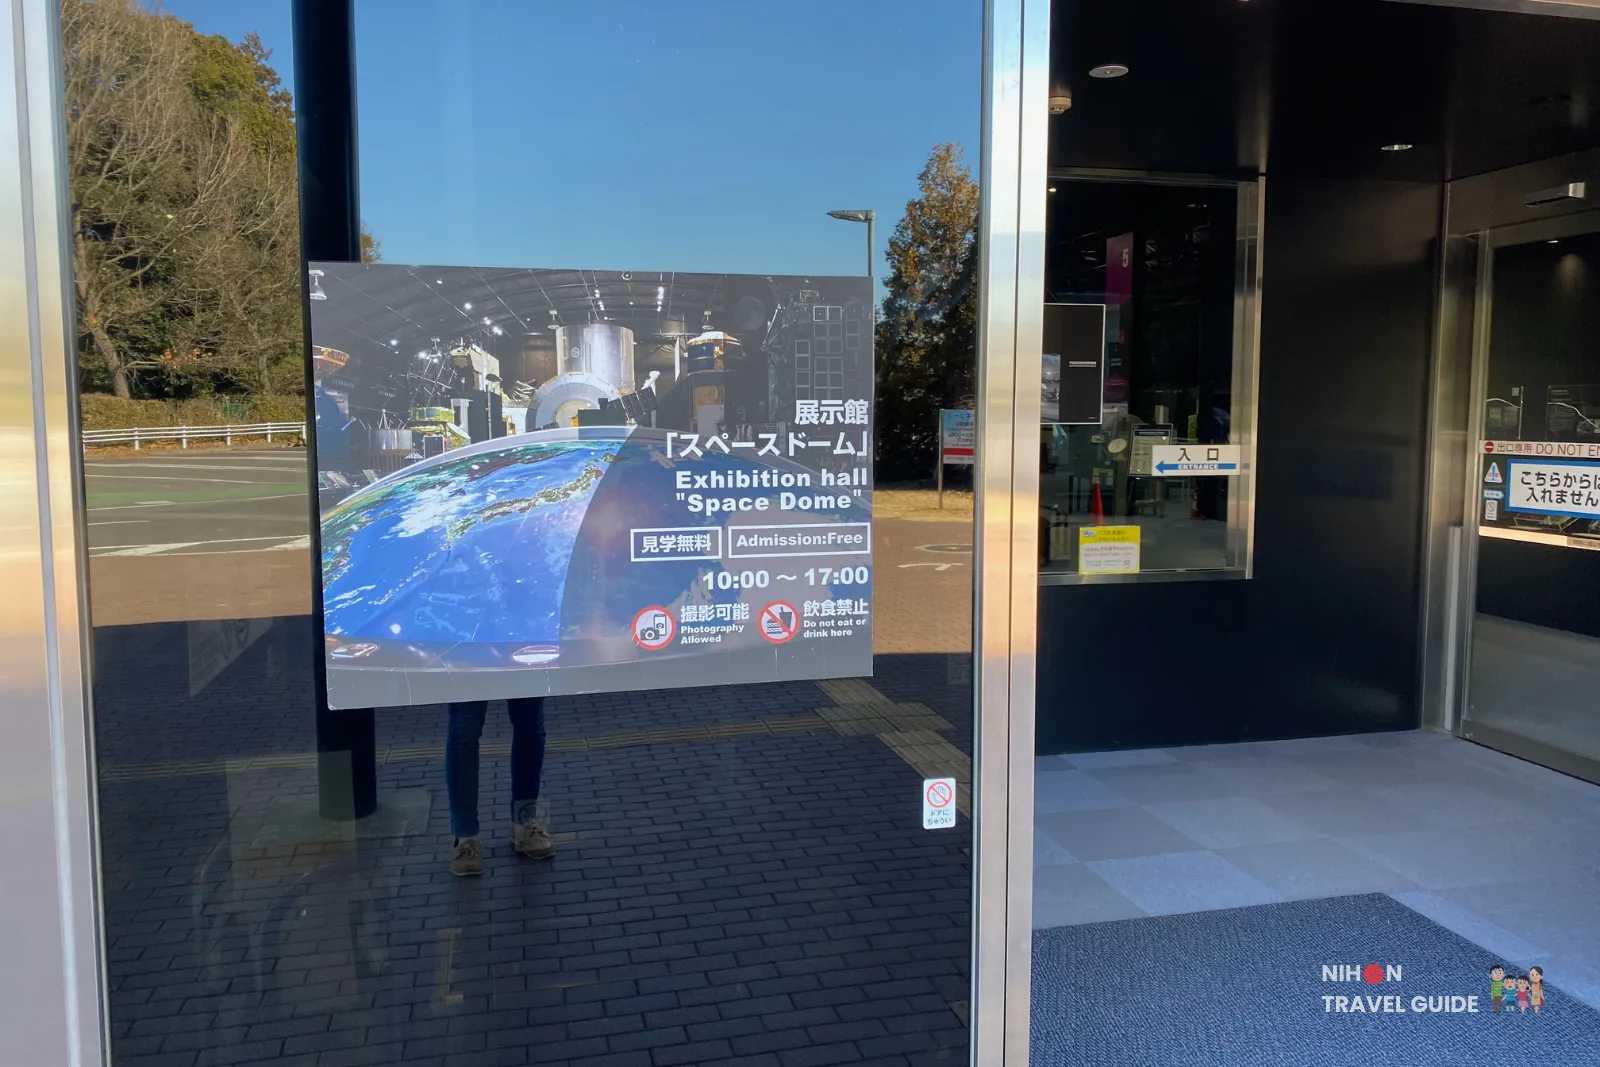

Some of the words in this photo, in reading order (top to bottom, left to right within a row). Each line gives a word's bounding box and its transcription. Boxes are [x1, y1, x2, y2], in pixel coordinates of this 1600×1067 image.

[794, 399, 869, 425] 展示館
[666, 430, 868, 459] 「スペースドーム」
[1497, 443, 1532, 452] 出口専用
[1536, 443, 1554, 455] DO
[1557, 444, 1584, 455] NOT
[676, 469, 811, 489] Exhibition
[821, 468, 868, 486] hall
[676, 493, 770, 516] "Space
[780, 489, 862, 510] Dome"
[641, 534, 712, 553] 見学無料
[736, 532, 864, 548] Admission:Free
[702, 570, 770, 590] 10:00
[804, 567, 869, 586] 17:00
[680, 602, 750, 622] 撮影可能
[803, 598, 869, 616] 飲食禁止
[680, 624, 744, 636] Photography
[803, 619, 816, 628] Do
[819, 618, 834, 627] not
[837, 618, 852, 626] eat
[680, 635, 722, 645] Allowed
[803, 628, 828, 637] drink
[831, 628, 853, 636] here
